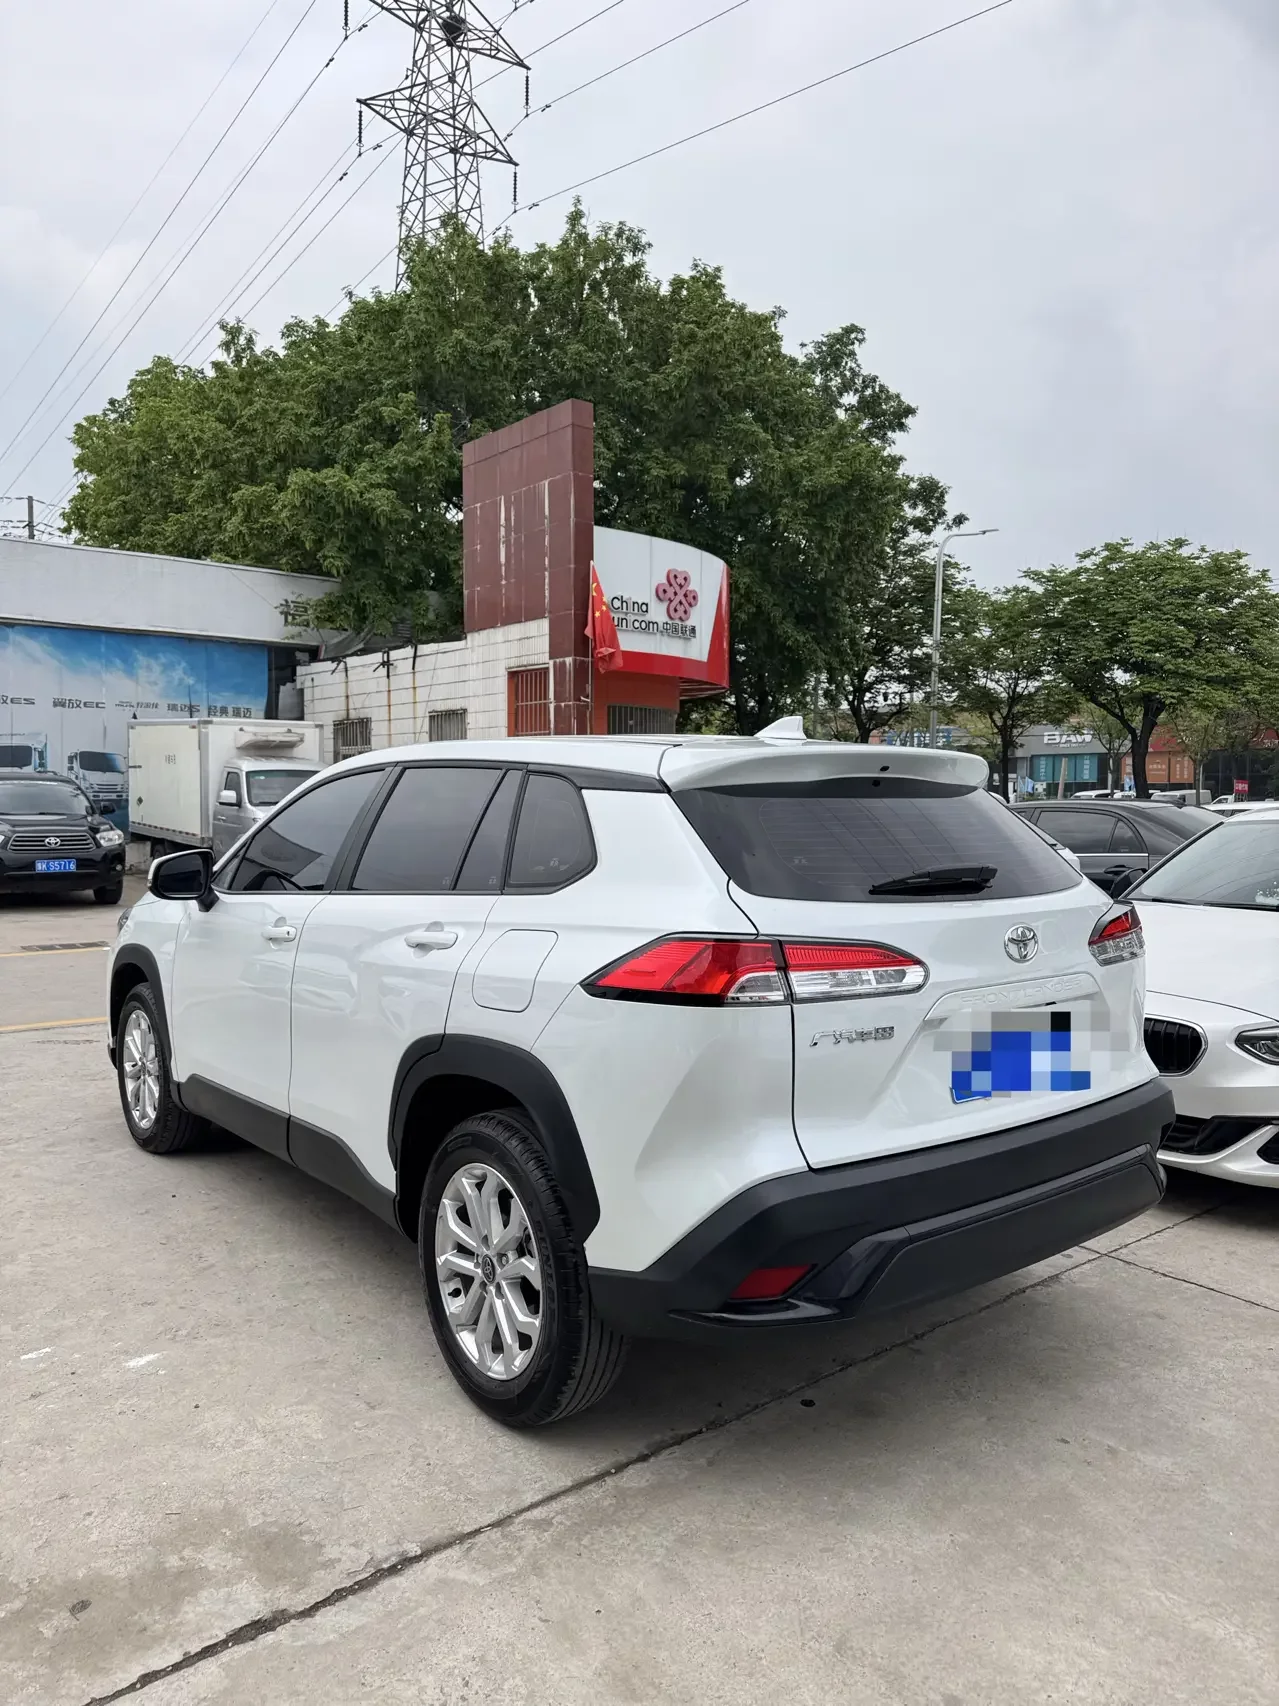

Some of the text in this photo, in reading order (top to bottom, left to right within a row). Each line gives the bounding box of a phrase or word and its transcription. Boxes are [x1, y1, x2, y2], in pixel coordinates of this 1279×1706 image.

[611, 595, 648, 614] China
[612, 614, 659, 633] unicom
[662, 620, 696, 639] 中国联通
[52, 697, 106, 709] 翼放EC
[1043, 730, 1093, 744] BAW
